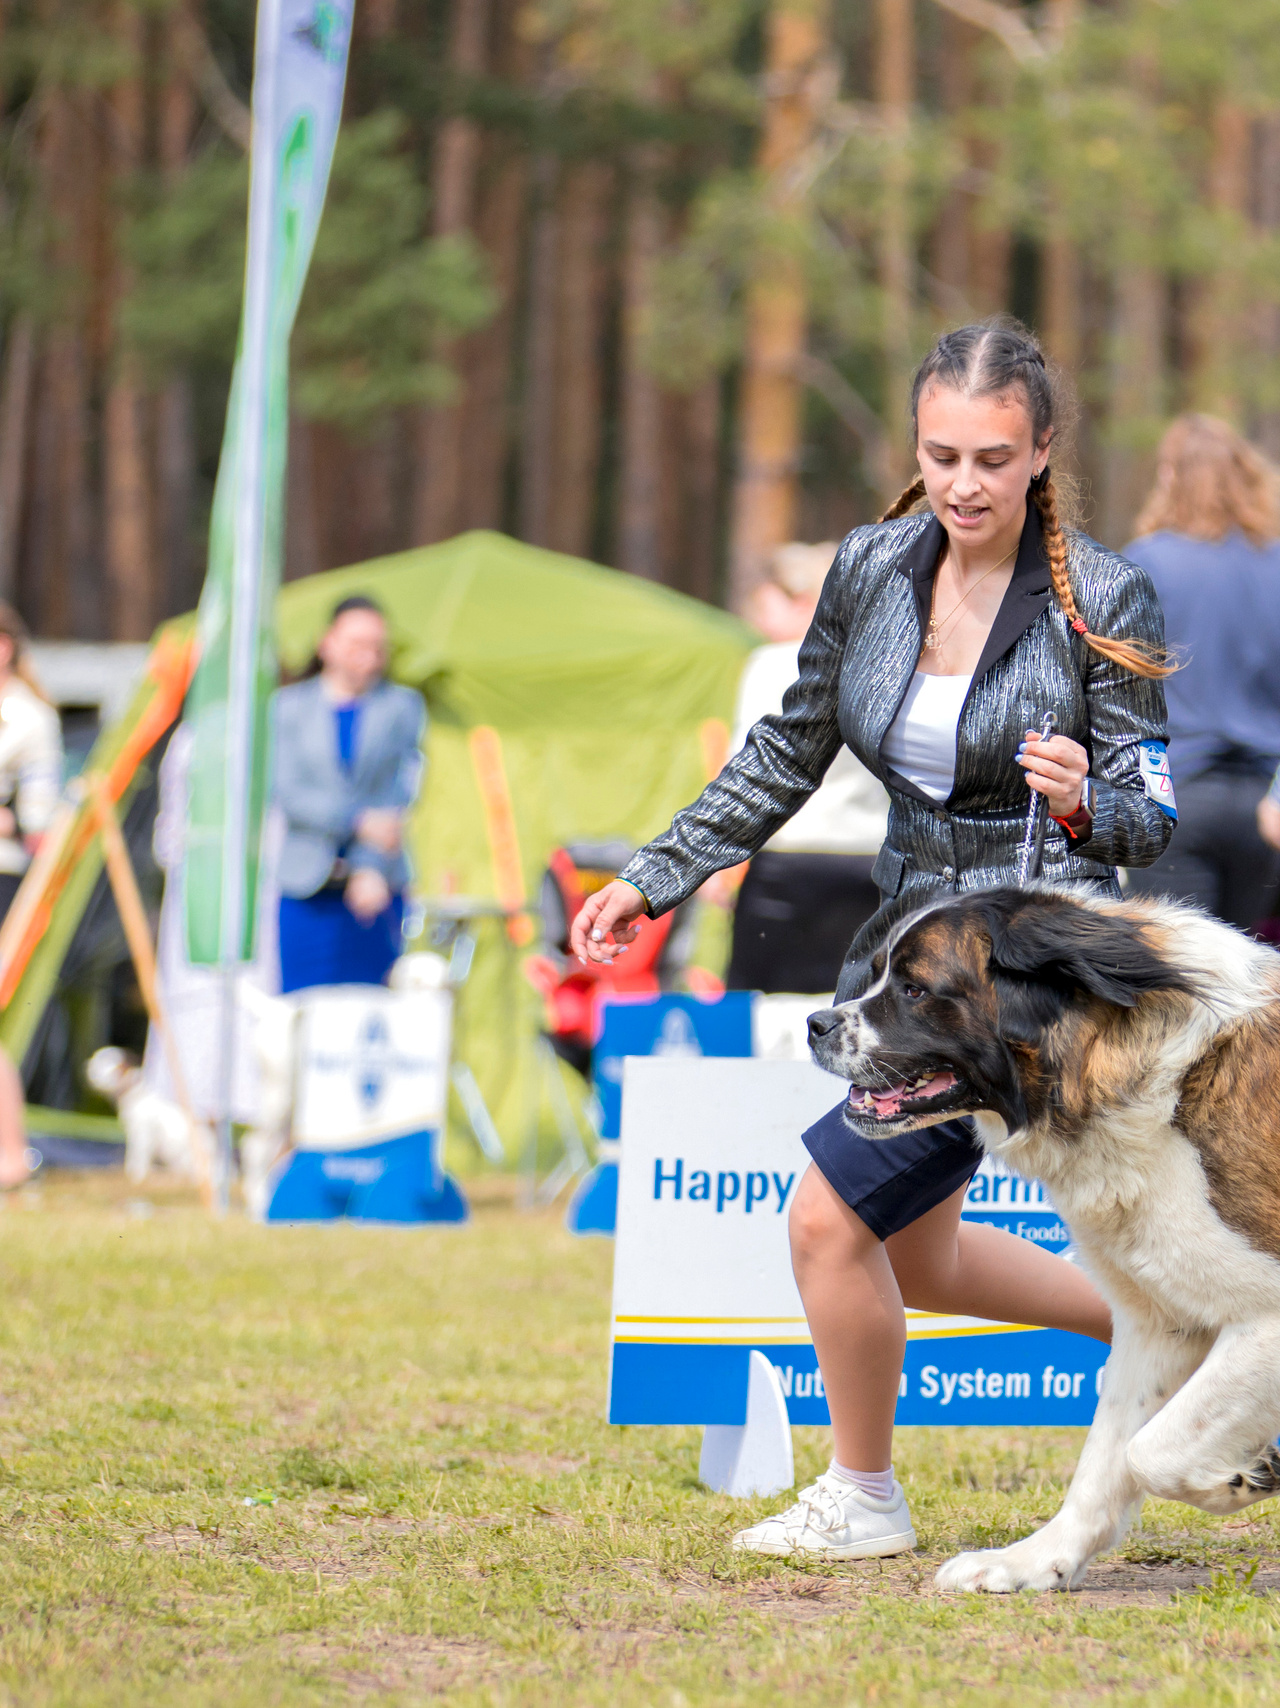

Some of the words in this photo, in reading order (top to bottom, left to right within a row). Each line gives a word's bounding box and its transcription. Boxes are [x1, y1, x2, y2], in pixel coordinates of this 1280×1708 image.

[653, 1157, 797, 1214] Happy
[967, 1172, 1045, 1203] arm
[919, 1364, 1032, 1406] System
[1042, 1364, 1086, 1399] for
